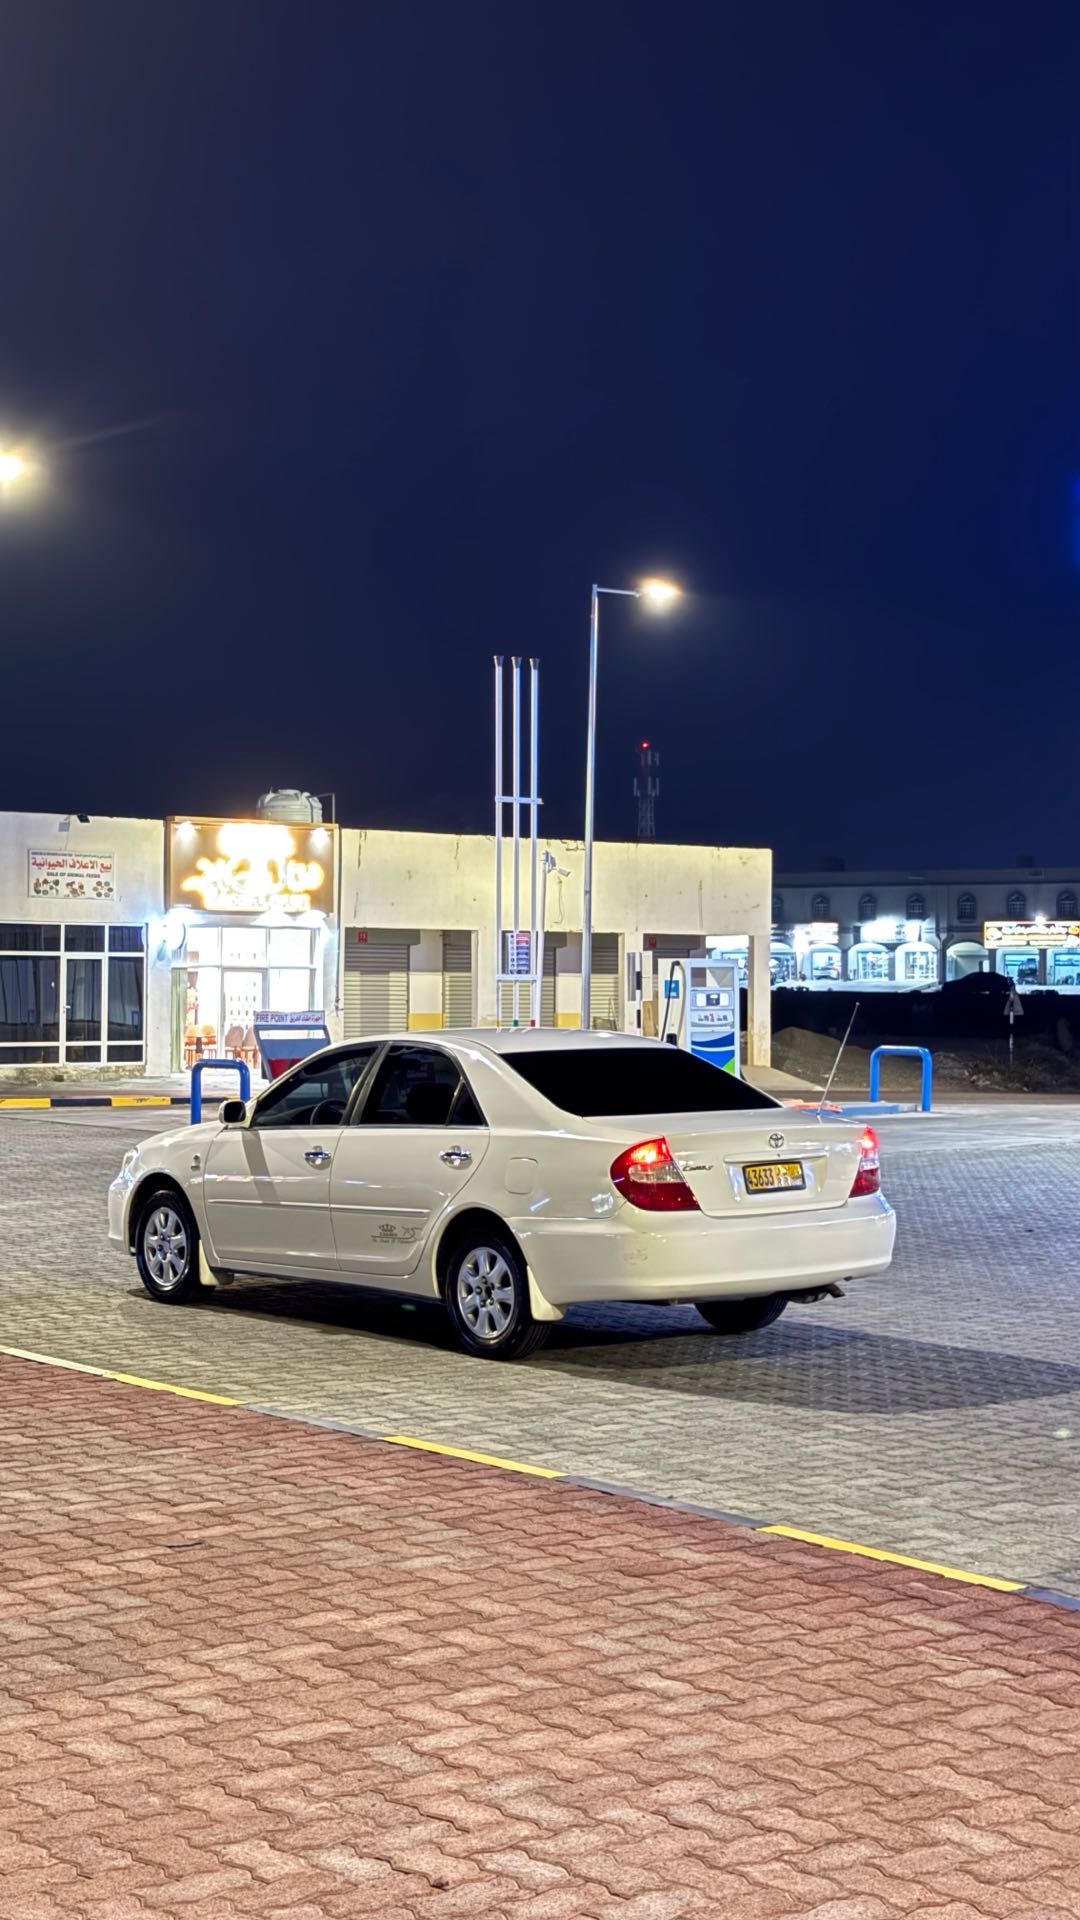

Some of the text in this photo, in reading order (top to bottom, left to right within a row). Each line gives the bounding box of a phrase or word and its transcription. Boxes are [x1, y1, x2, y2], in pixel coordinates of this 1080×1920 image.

[31, 857, 67, 870] الحيوانية
[99, 862, 112, 873] بيع
[255, 1012, 289, 1023] FIRE POINT
